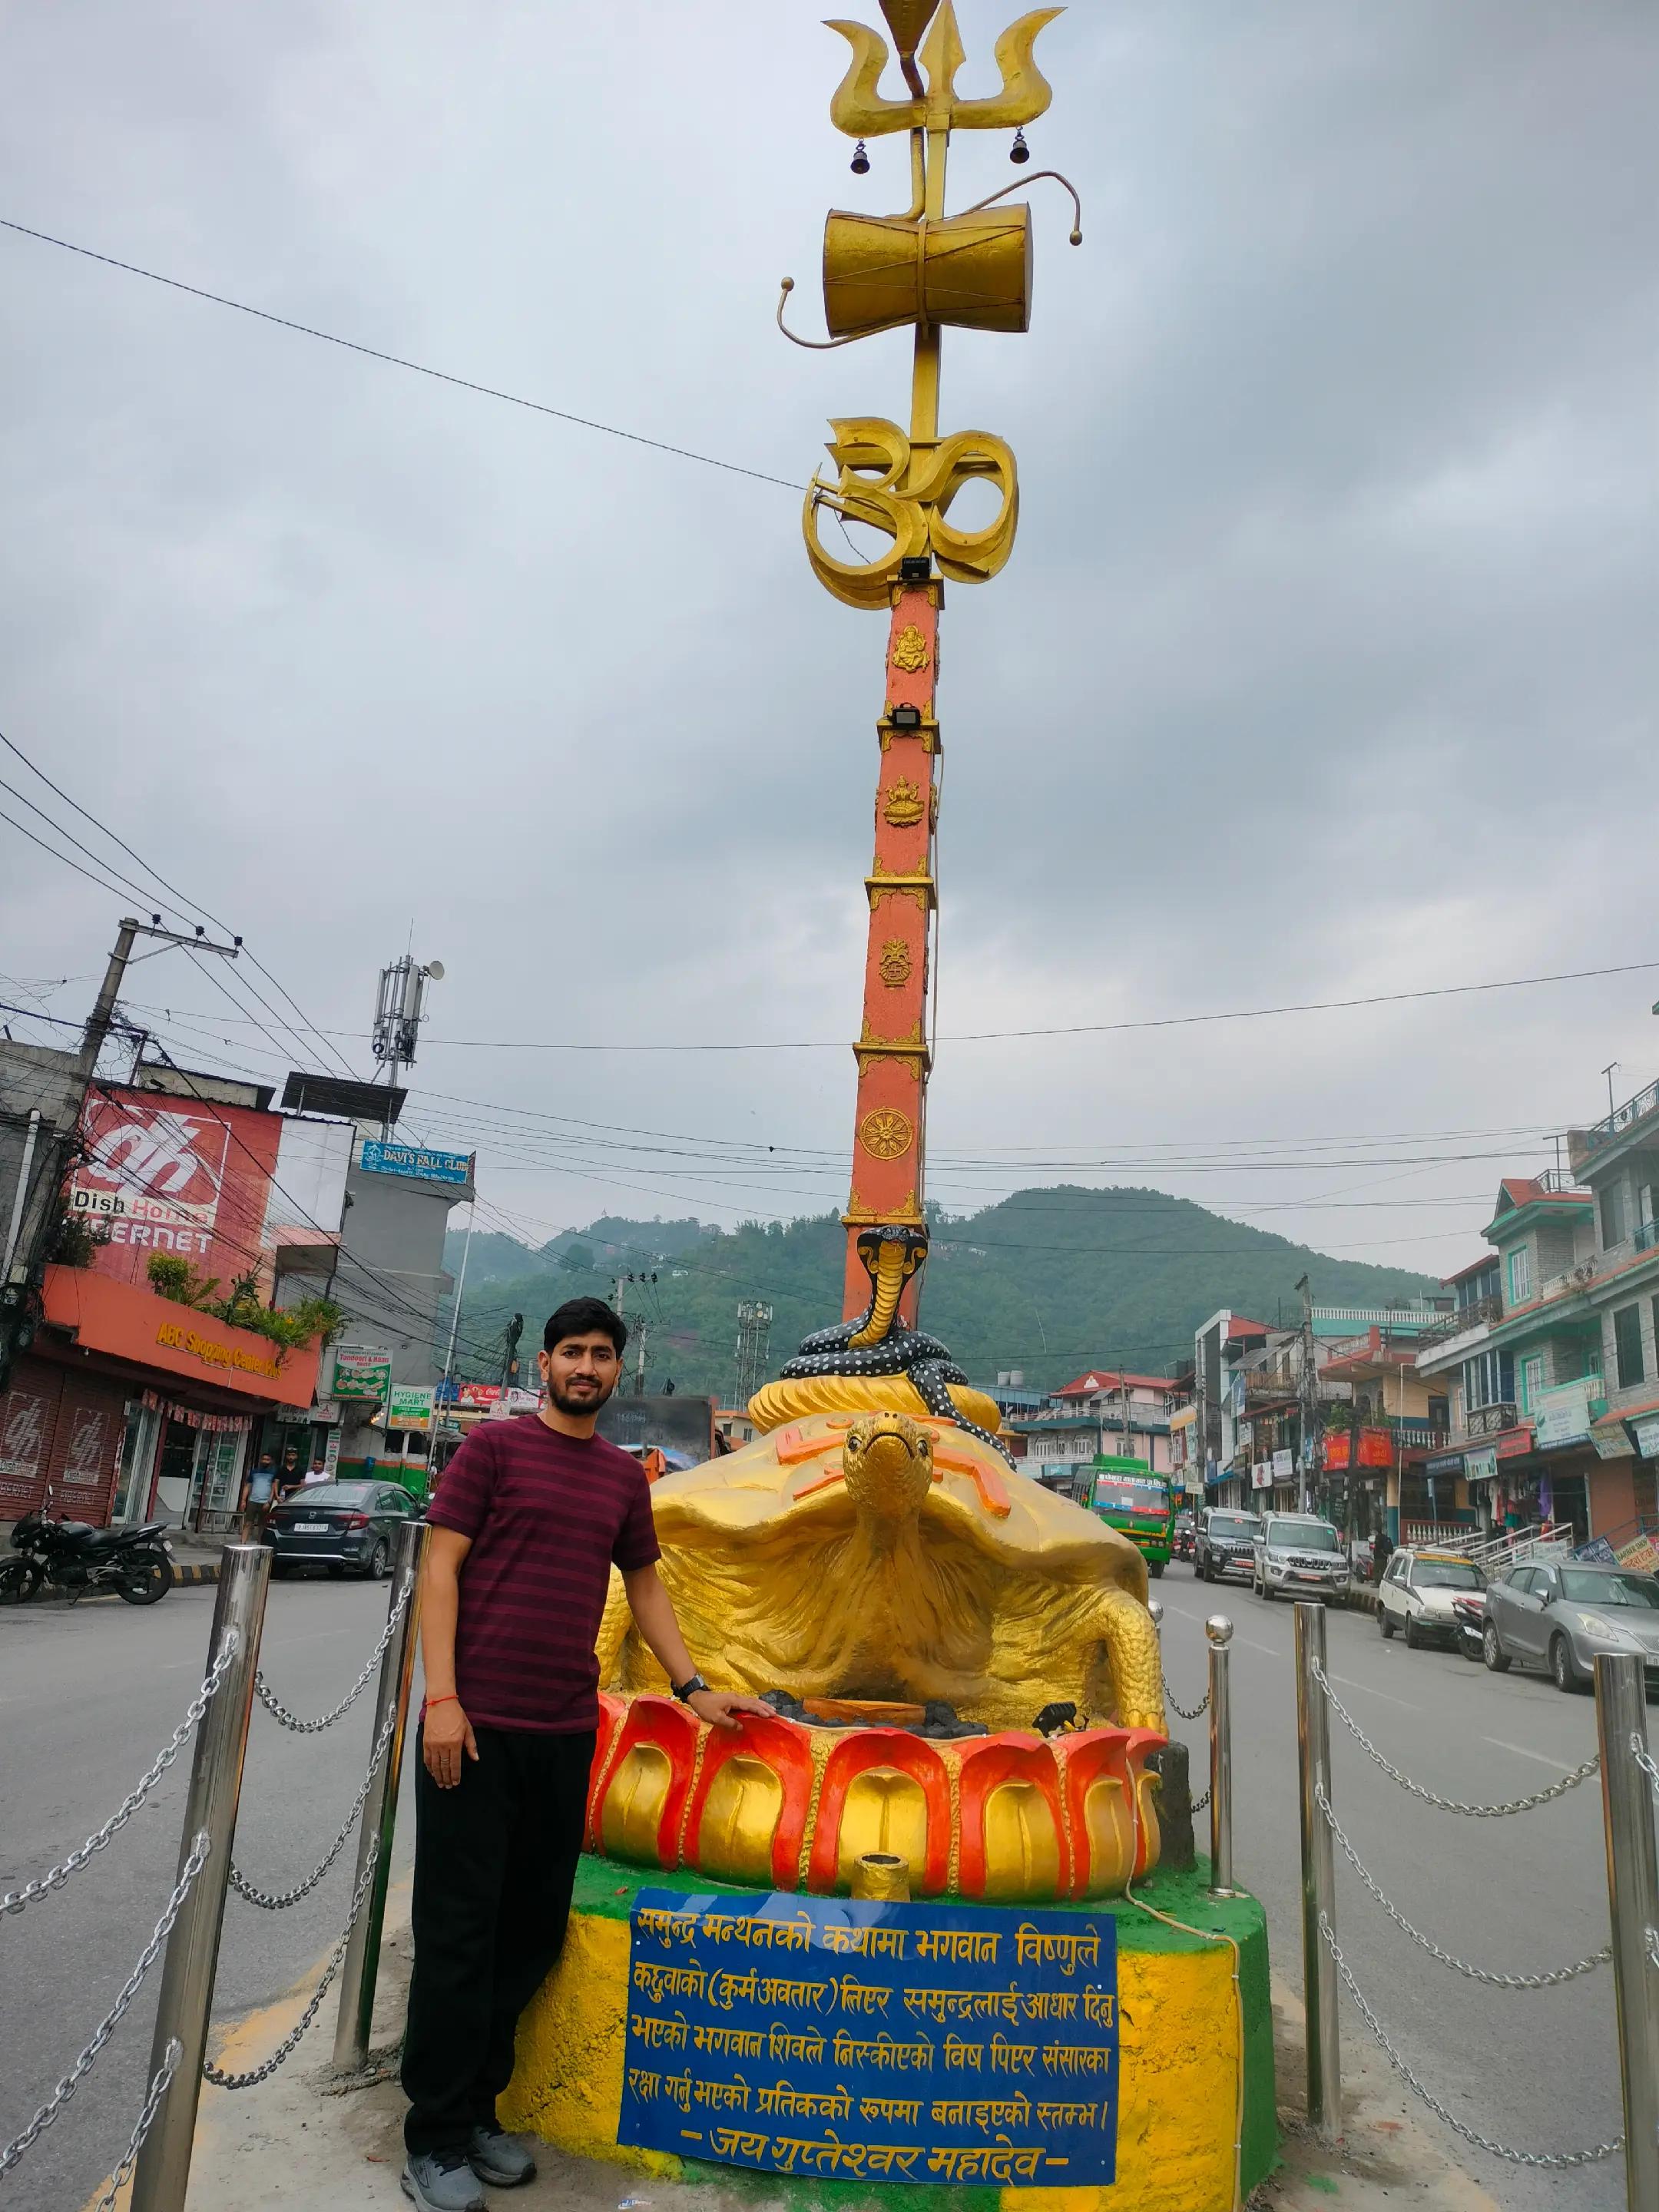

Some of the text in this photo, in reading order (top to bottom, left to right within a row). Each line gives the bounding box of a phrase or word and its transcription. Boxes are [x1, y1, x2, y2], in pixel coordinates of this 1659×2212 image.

[383, 1149, 416, 1164] DAVI'S
[75, 1191, 208, 1223] Dish Home
[158, 1322, 185, 1347] ABC
[185, 1330, 231, 1368] Shopping
[232, 1346, 263, 1371] Center
[394, 1391, 431, 1399] HYGIENE
[703, 1911, 816, 1953] मन्थनको
[822, 1926, 909, 1961] कथामा
[916, 1930, 1002, 1965] भगवान
[1015, 1922, 1101, 1976] विष्णुले
[840, 1974, 894, 2019] लिएर
[1021, 1992, 1080, 2022] आधार
[631, 2010, 691, 2051] भएको
[694, 2025, 769, 2058] भगवान
[769, 2022, 827, 2065] शिवले
[943, 2032, 985, 2073] विष
[990, 2032, 1038, 2077] पिएर
[1041, 2039, 1111, 2077] संसारका
[628, 2068, 661, 2104] रक्षा
[664, 2068, 692, 2113] गर्नु
[694, 2073, 752, 2113] भएको
[755, 2080, 855, 2121] प्रतिकको
[931, 2090, 1032, 2134] बनाइएको
[709, 2127, 770, 2164] जय
[771, 2128, 926, 2181] गुप्तेश्वर
